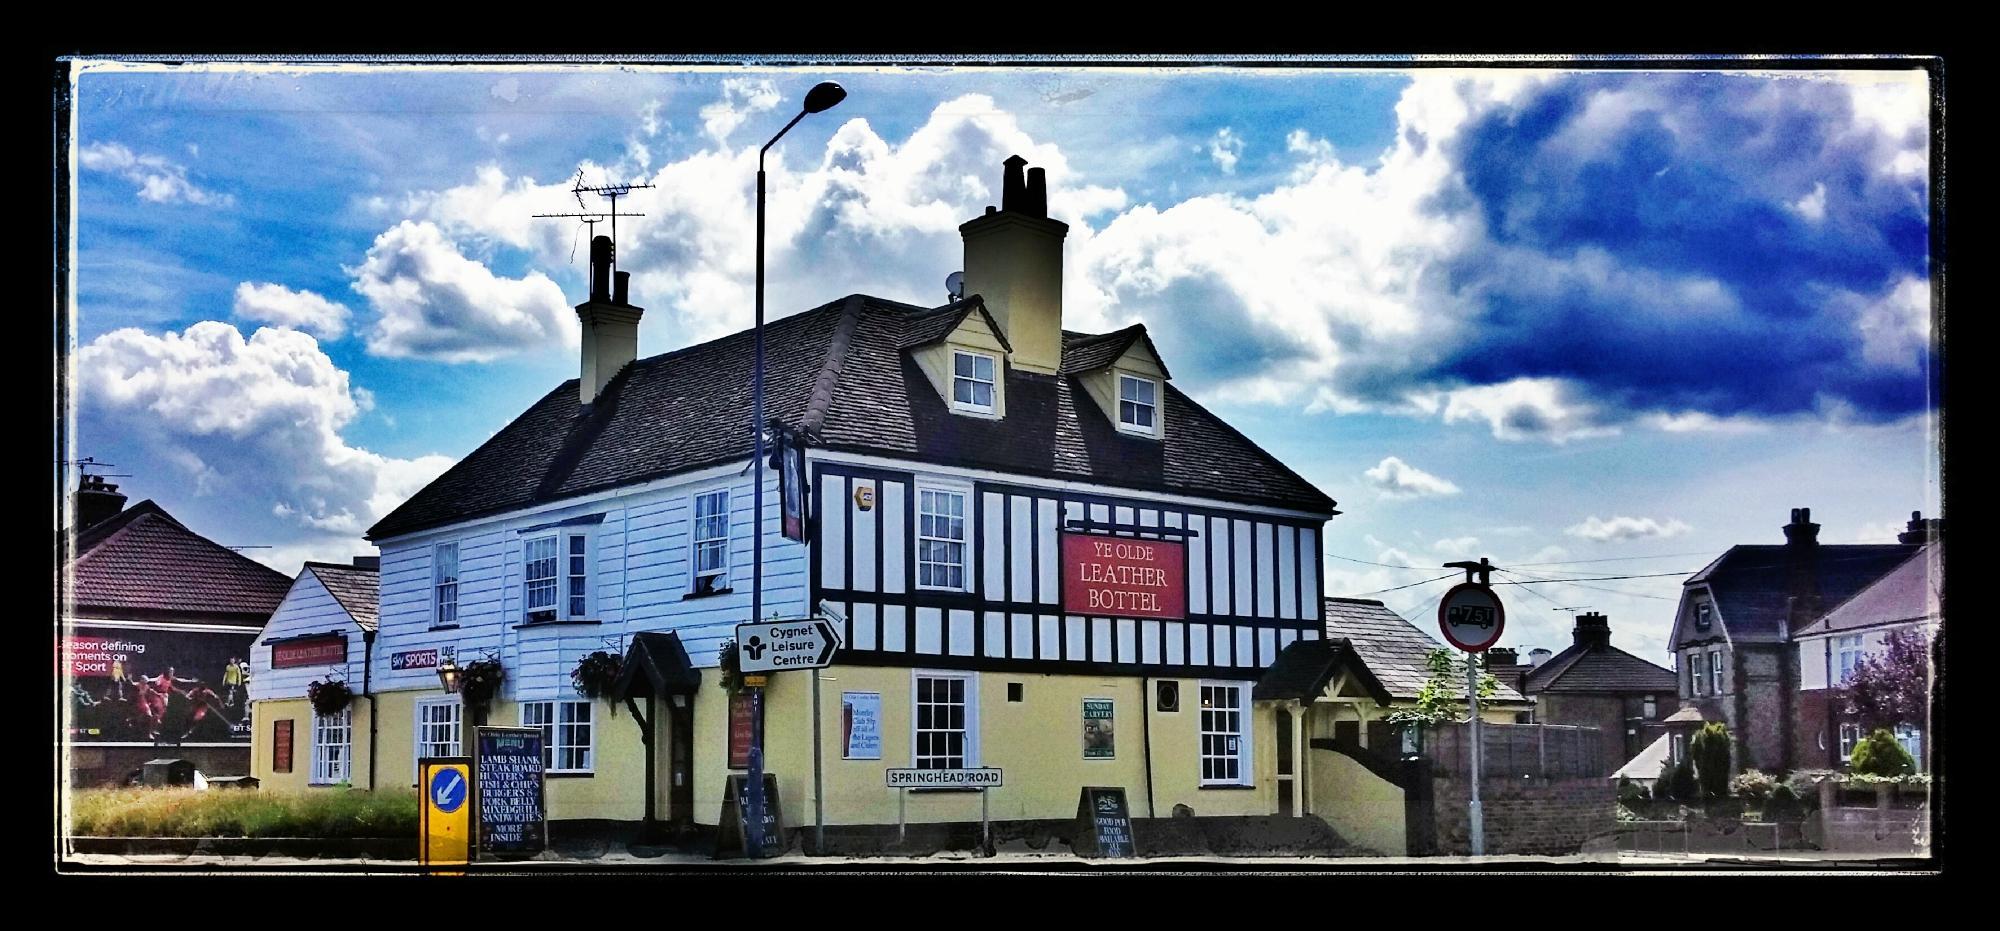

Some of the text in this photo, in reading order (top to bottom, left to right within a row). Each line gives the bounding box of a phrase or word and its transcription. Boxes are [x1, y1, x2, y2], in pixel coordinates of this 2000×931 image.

[1093, 541, 1154, 561] YE OLDE
[1079, 562, 1168, 587] LEATHER
[1088, 588, 1162, 612] BOTTEL
[770, 624, 814, 639] Cygnet
[100, 640, 146, 654] defining
[771, 640, 815, 652] Leisure
[112, 653, 127, 661] on
[405, 652, 436, 667] SPORTS
[772, 654, 814, 666] Centre
[75, 661, 107, 673] Sport
[1086, 702, 1110, 710] SUNDAY
[1084, 710, 1113, 718] CARVERY
[496, 738, 525, 749] MENU
[481, 755, 541, 765] LAMB SHANK
[479, 763, 542, 773] STEAK BOARD
[891, 772, 999, 783] SPRINGHEAD ROAD
[479, 780, 500, 789] FISH
[502, 780, 510, 789] &
[482, 797, 536, 806] PORK BELLY
[496, 824, 523, 833] MORE
[490, 833, 522, 842] INSIDE
